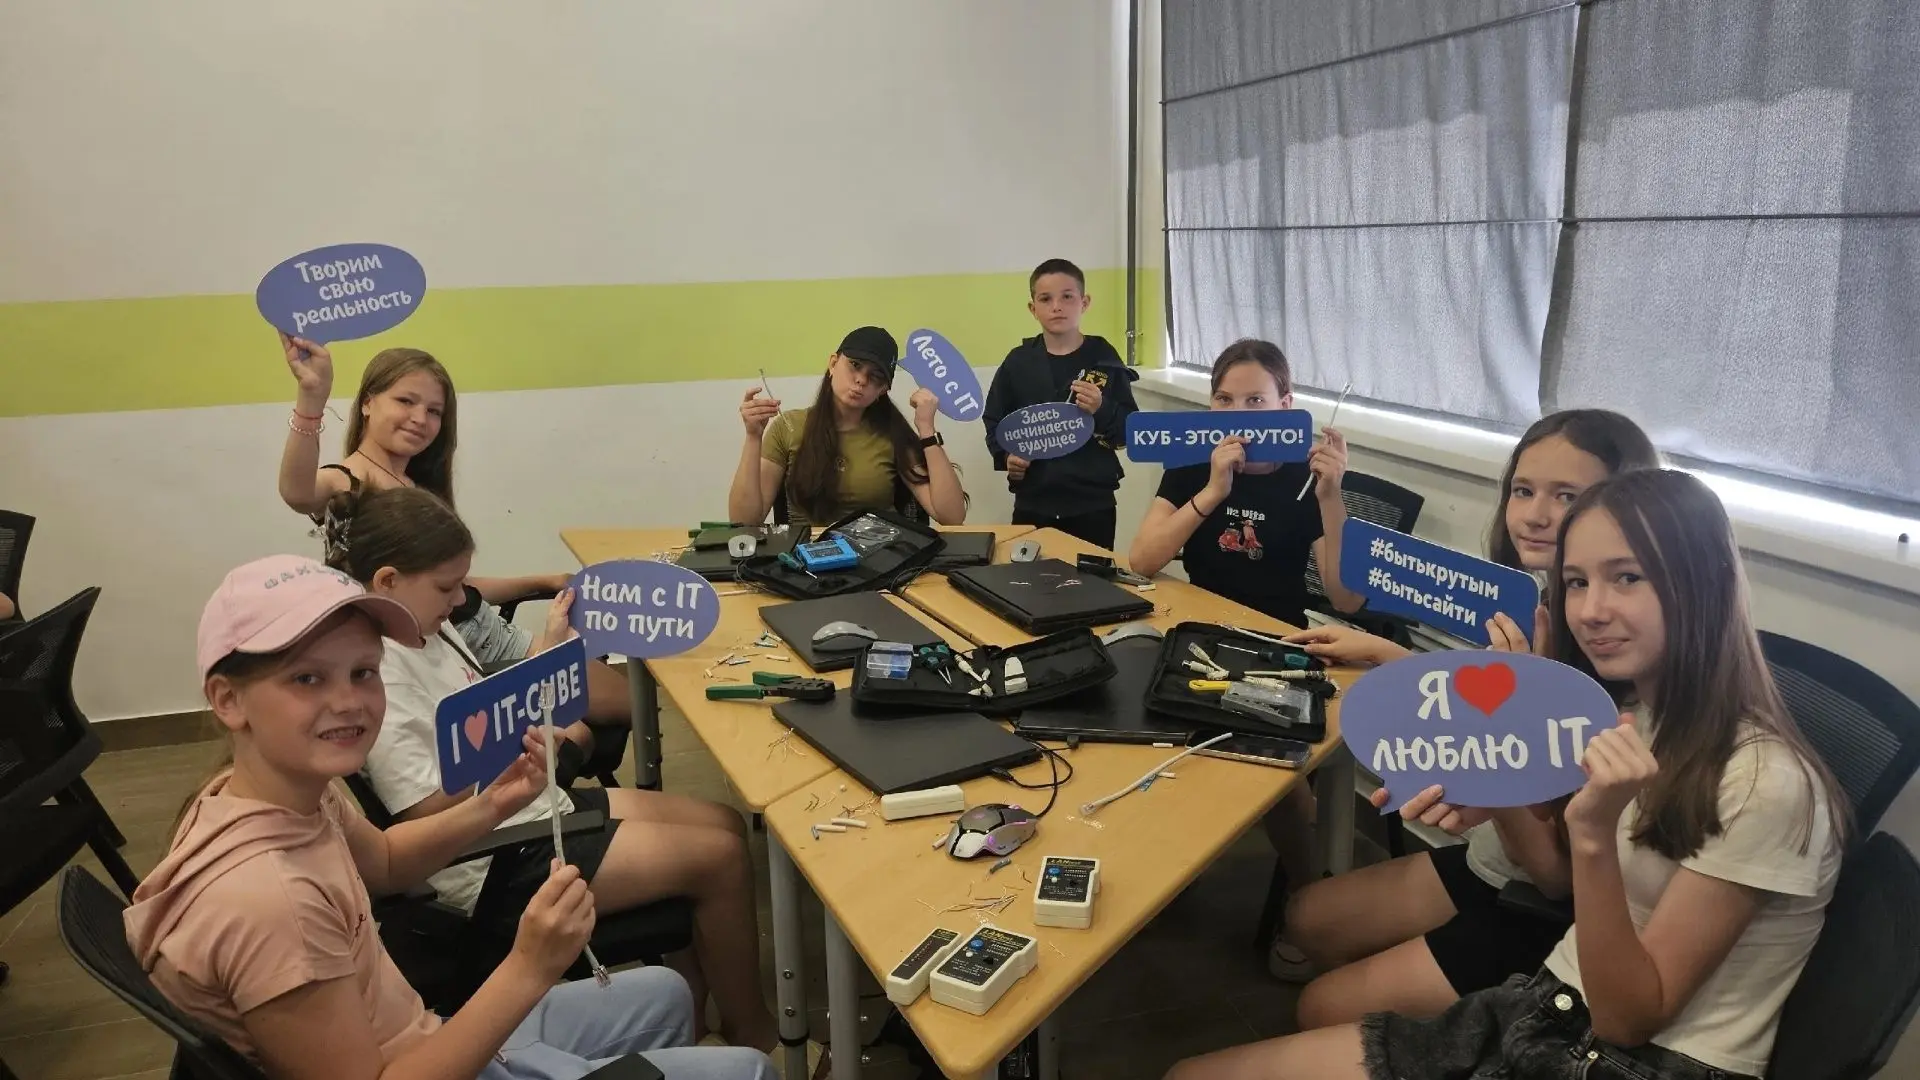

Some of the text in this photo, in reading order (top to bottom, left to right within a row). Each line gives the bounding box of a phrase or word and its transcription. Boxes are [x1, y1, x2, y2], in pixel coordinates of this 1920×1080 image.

[294, 254, 383, 283] Творим
[319, 276, 375, 301] свою
[292, 291, 412, 333] реальность
[912, 335, 948, 379] Лето
[953, 391, 979, 414] IT
[1004, 416, 1084, 442] начинается
[1020, 408, 1060, 425] Здесь
[1017, 432, 1076, 456] будущее
[1133, 430, 1171, 446] КУБ
[1184, 429, 1225, 445] ЭТО
[1370, 537, 1499, 601] #бытькрутым
[580, 573, 704, 610] Нам с IT
[1368, 566, 1477, 627] #бытьсайти
[584, 609, 695, 643] по пути
[1416, 670, 1452, 720] Я
[450, 722, 461, 766] I
[1546, 716, 1592, 768] IT
